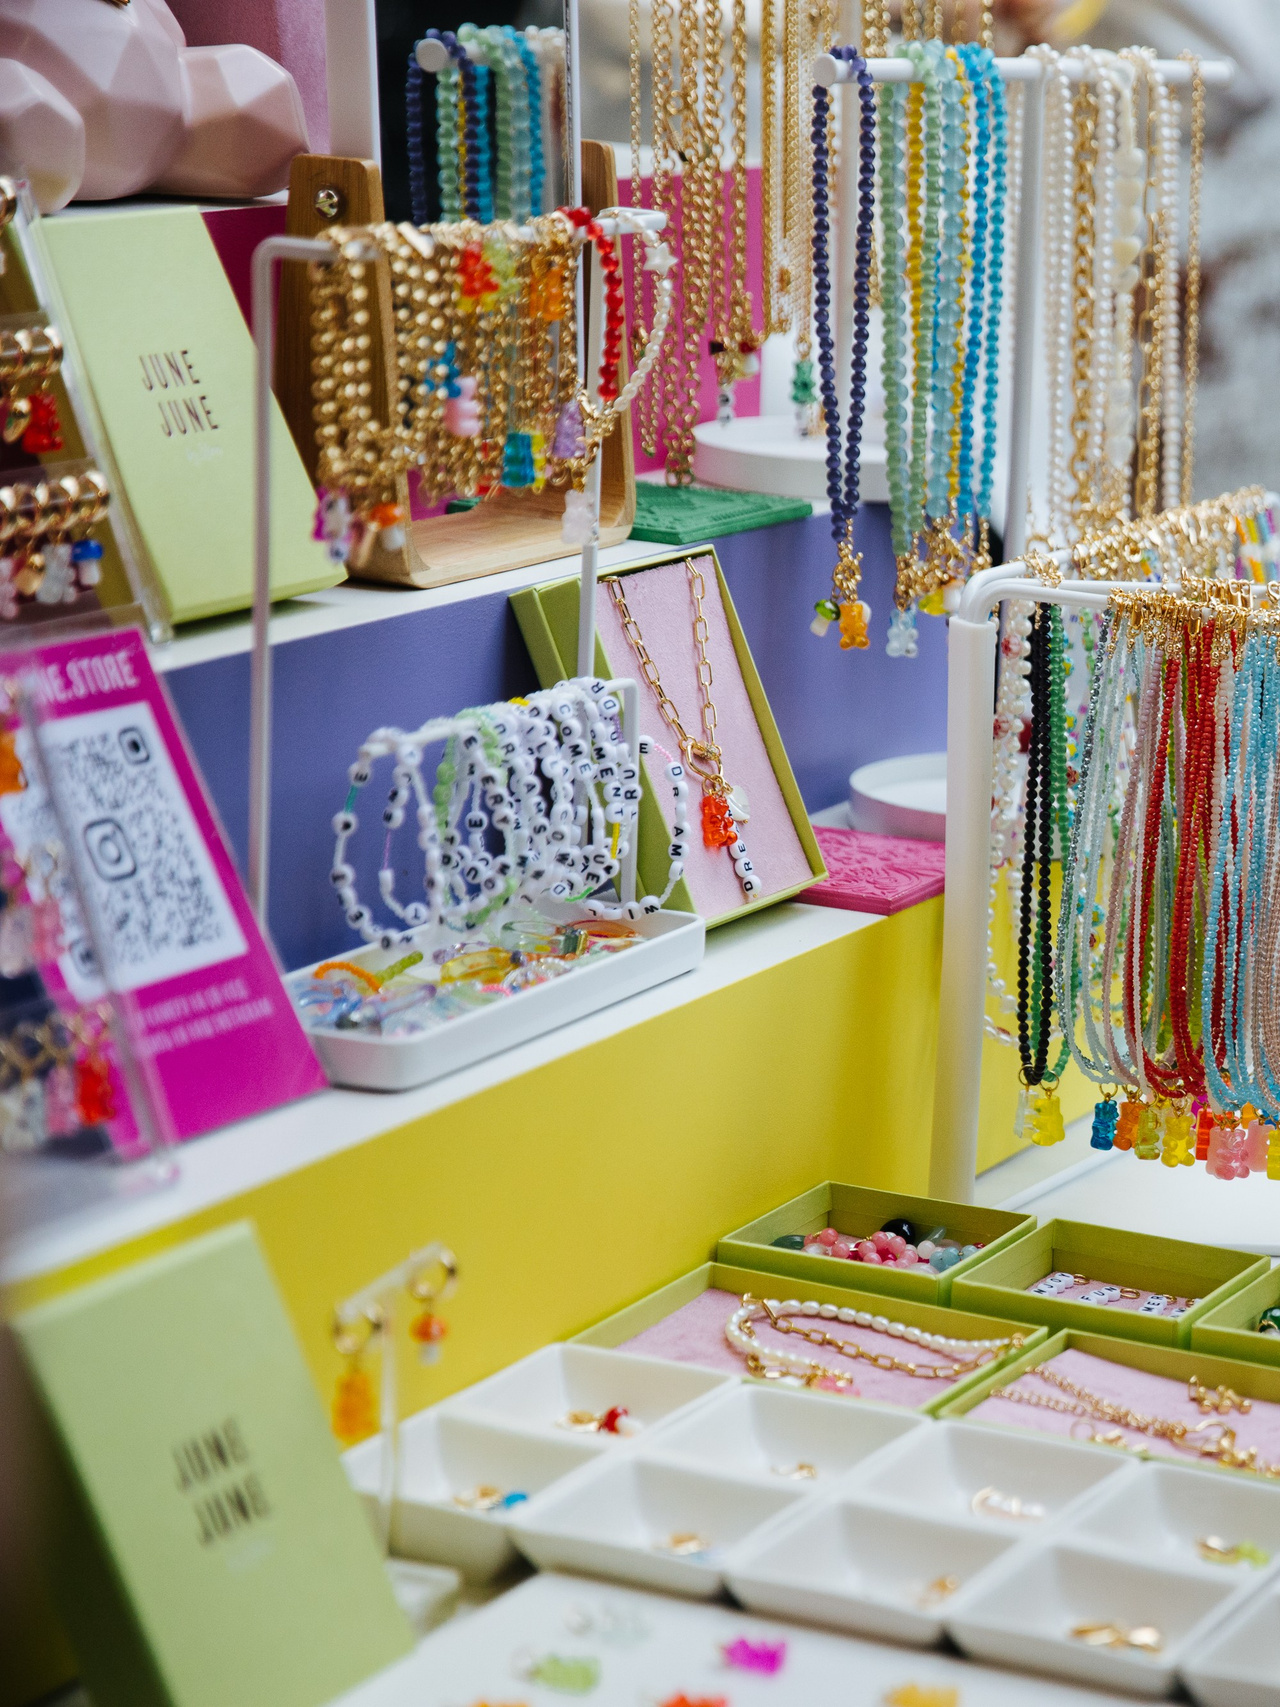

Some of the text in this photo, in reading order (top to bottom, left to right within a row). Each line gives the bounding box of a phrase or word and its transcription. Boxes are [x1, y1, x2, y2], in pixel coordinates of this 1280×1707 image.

[138, 350, 201, 392] JUNE
[157, 395, 220, 438] JUNE
[1033, 1272, 1071, 1295] NJOY
[1080, 1286, 1118, 1302] FUN
[171, 1416, 251, 1492] JUNE
[194, 1473, 271, 1546] JUNE
